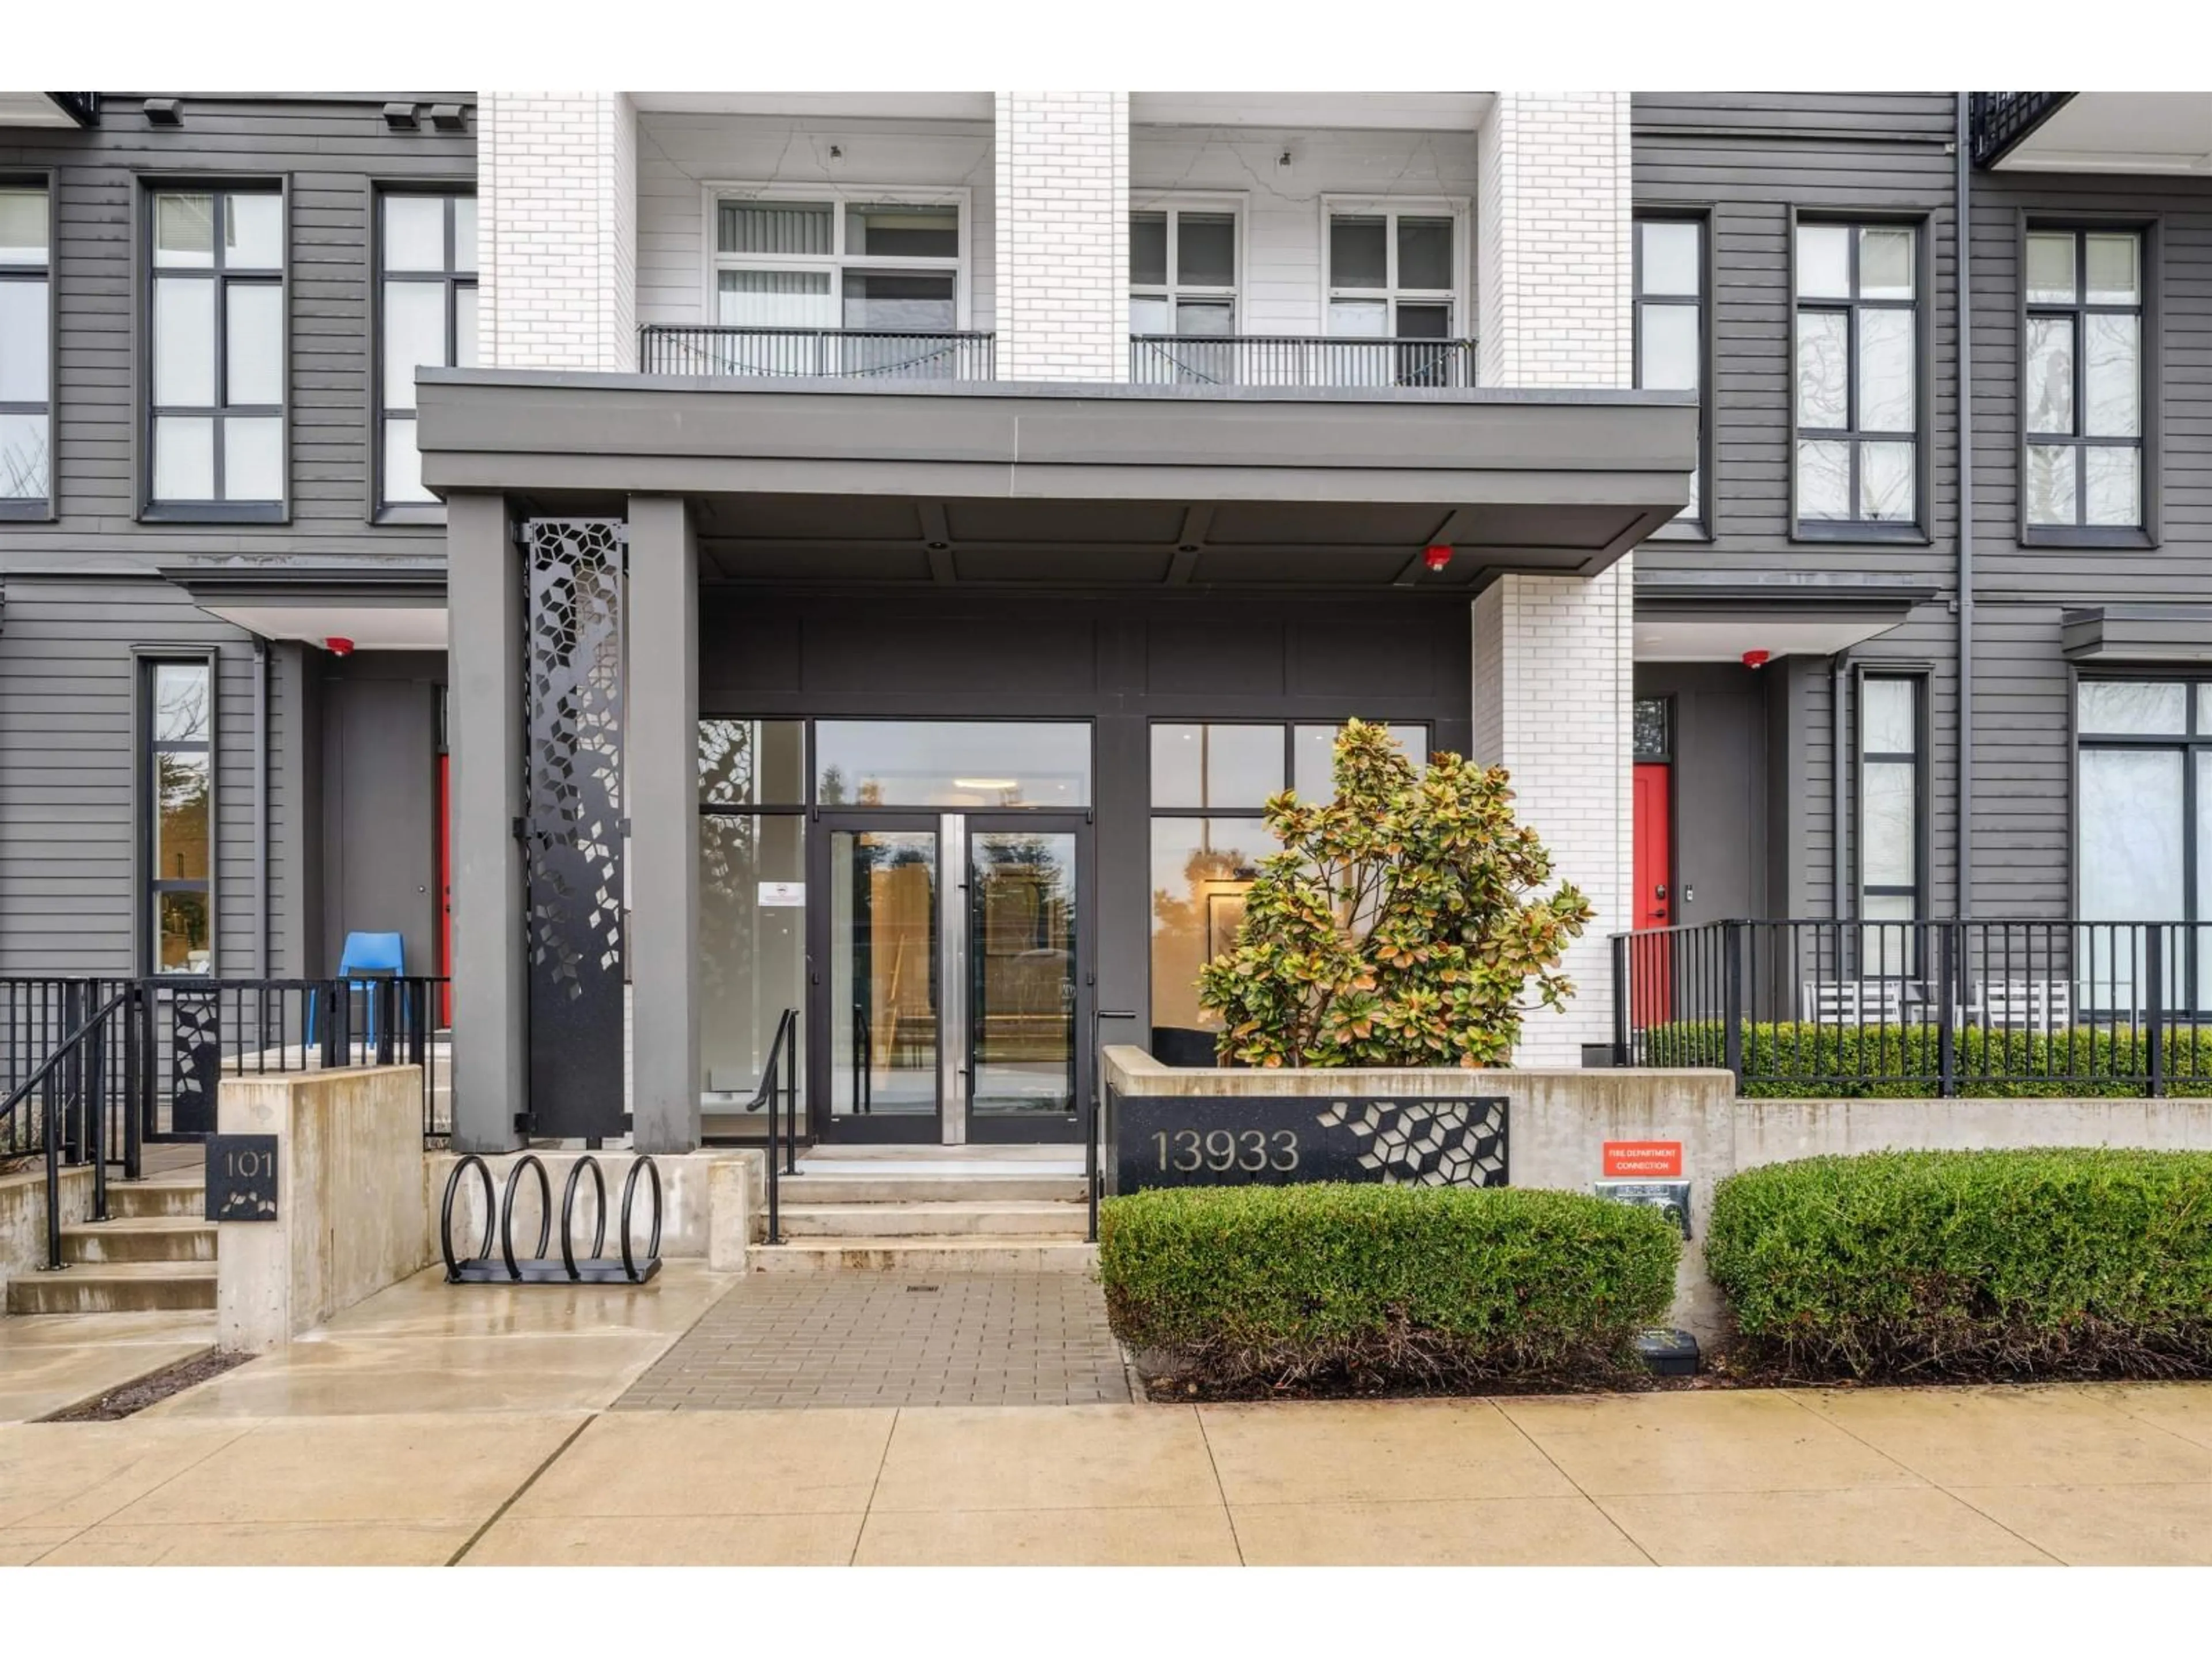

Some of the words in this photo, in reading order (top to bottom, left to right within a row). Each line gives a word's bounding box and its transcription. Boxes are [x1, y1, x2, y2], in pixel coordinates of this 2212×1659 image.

[1152, 1130, 1300, 1172] 13933
[228, 1152, 272, 1177] 101
[1616, 1161, 1668, 1169] CONNECTION
